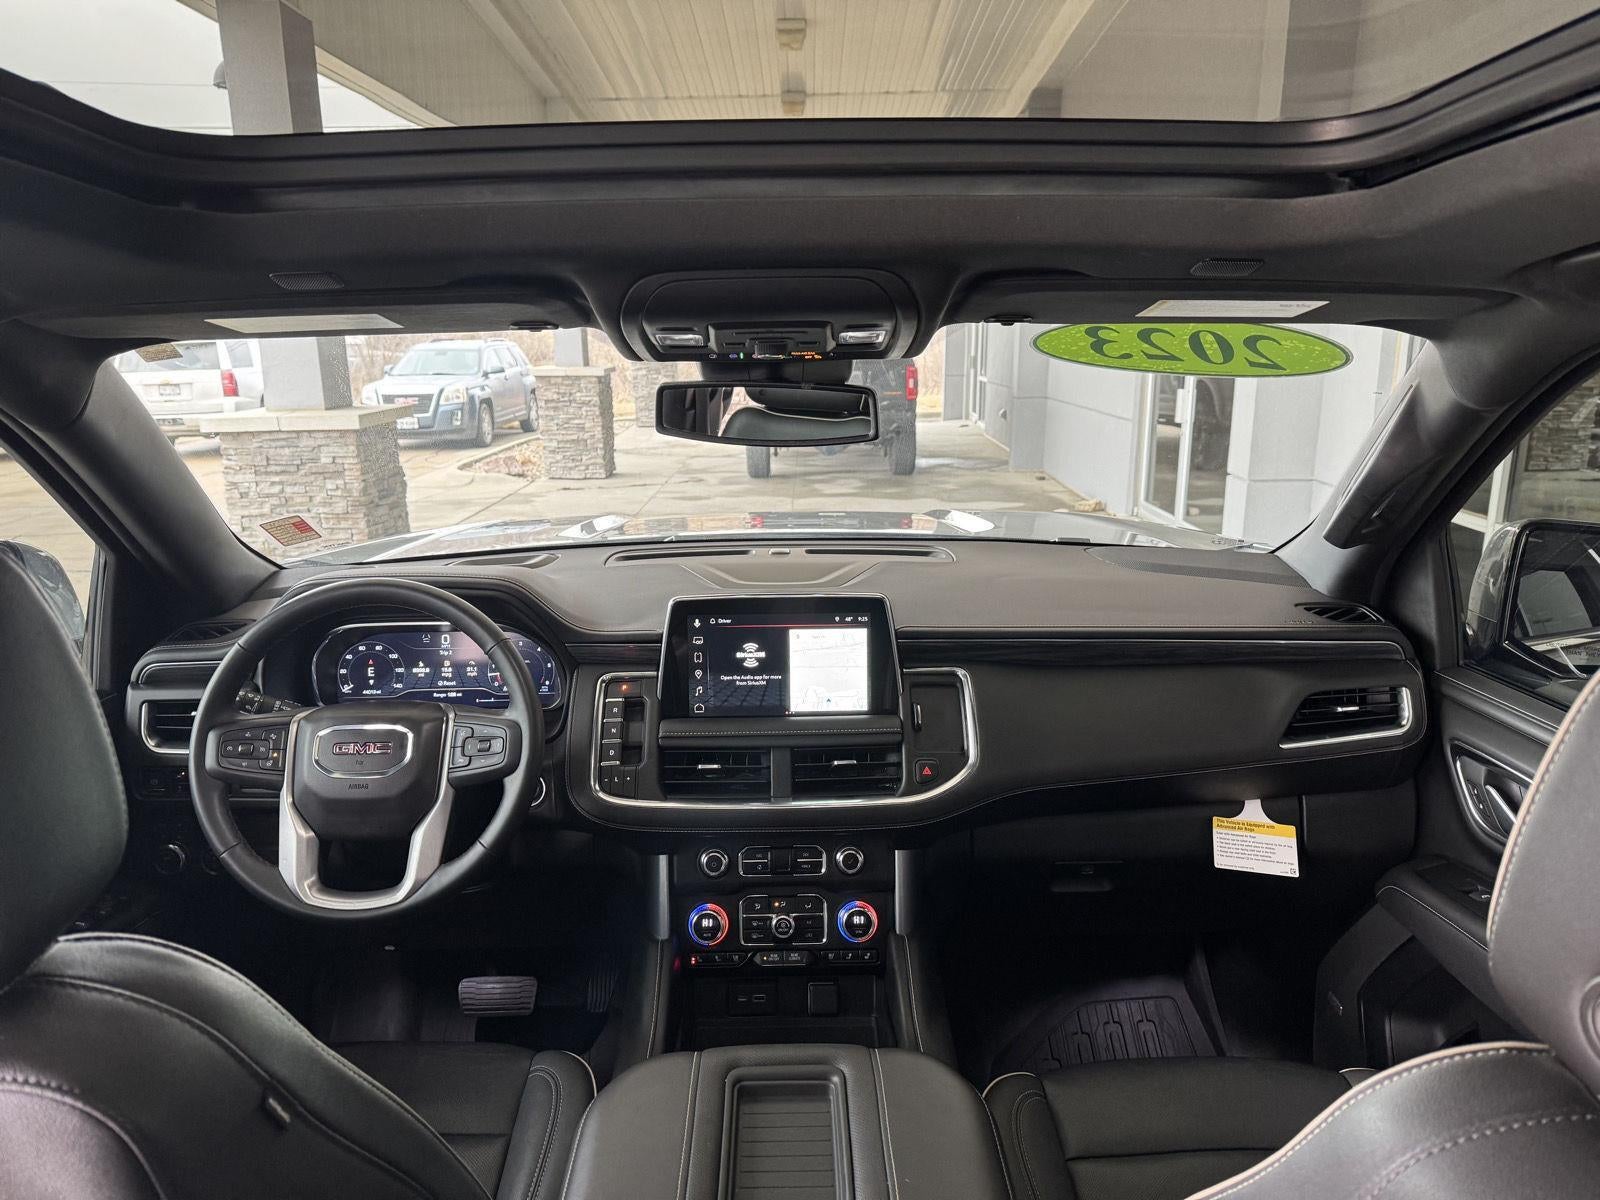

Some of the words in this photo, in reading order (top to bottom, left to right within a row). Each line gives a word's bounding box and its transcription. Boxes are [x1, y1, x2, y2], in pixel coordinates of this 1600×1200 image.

[442, 634, 450, 644] 0
[368, 666, 374, 676] E
[333, 742, 393, 755] GMC
[702, 918, 713, 928] HI
[854, 916, 864, 924] HI
